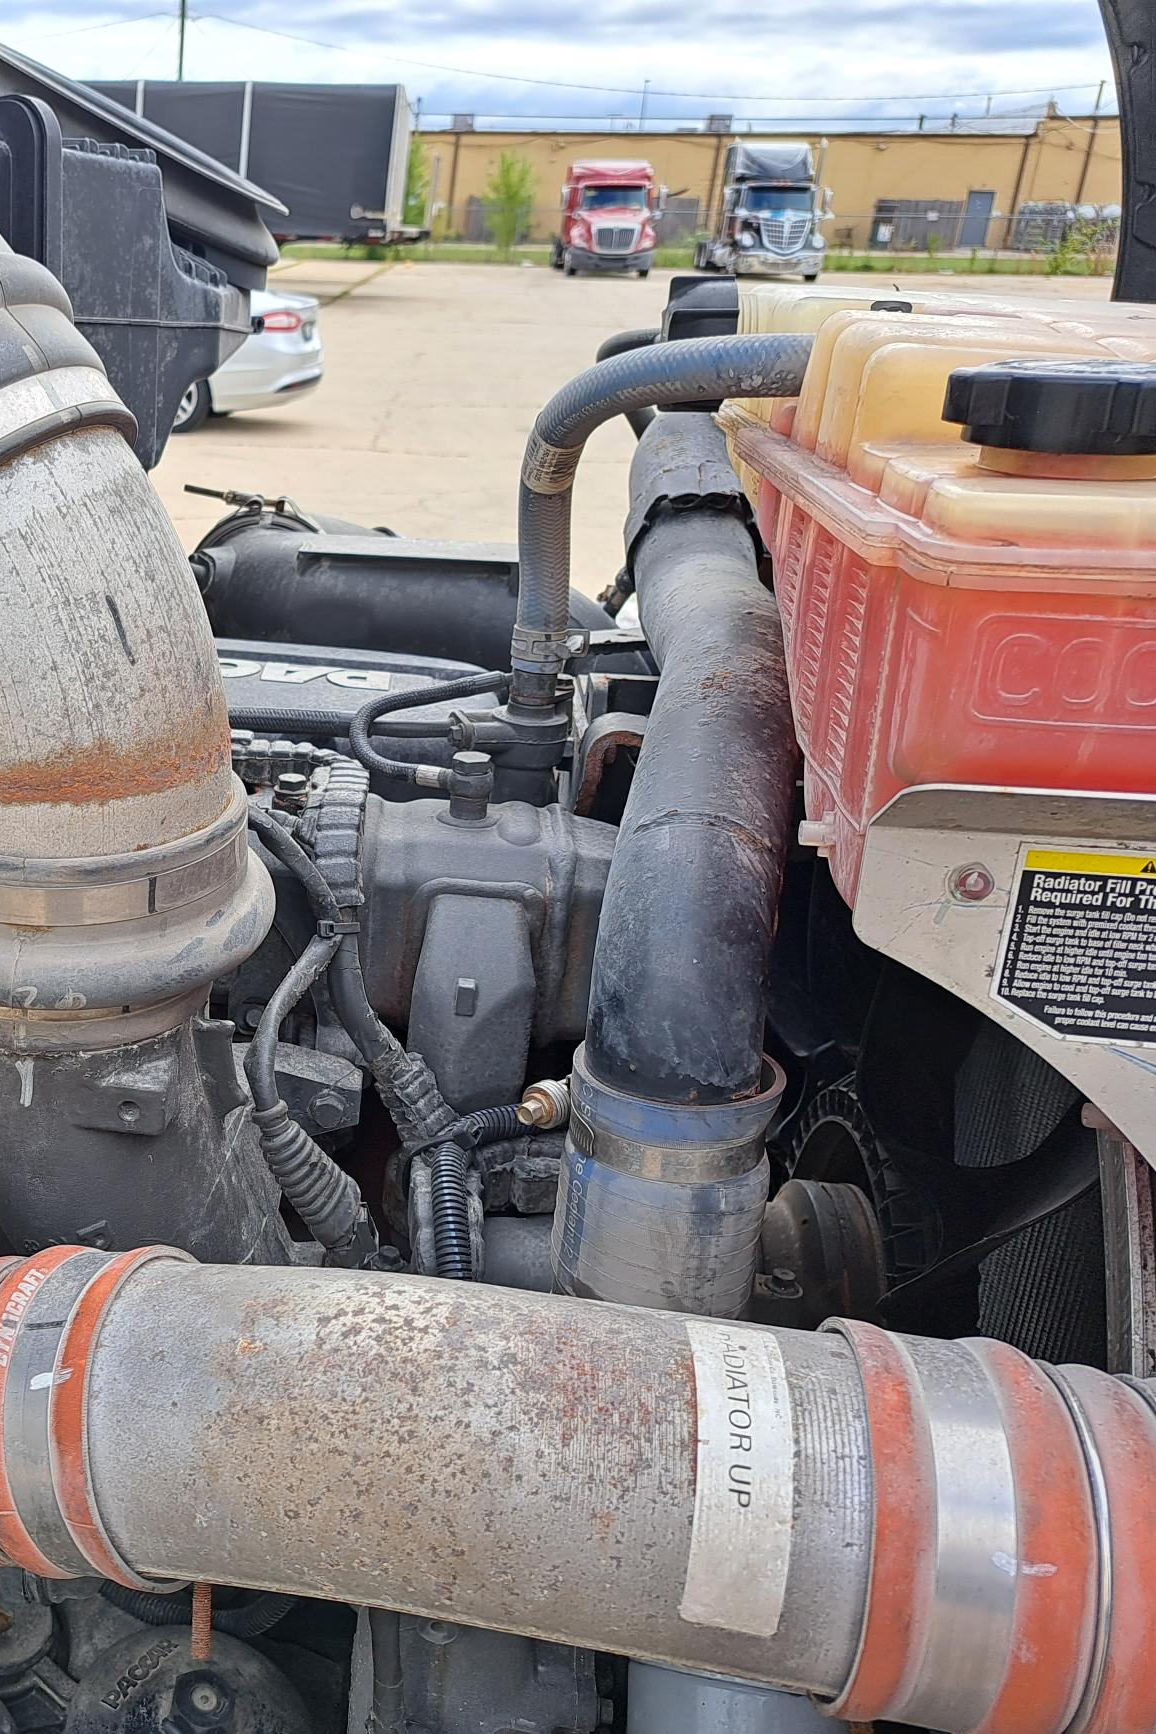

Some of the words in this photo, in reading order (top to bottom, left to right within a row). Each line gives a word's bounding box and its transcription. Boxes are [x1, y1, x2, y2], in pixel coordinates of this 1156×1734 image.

[1033, 874, 1102, 892] Radiator
[1106, 879, 1132, 894] Fill
[1030, 888, 1103, 908] Required
[1107, 893, 1135, 907] For
[1028, 906, 1054, 915] Remove
[1055, 908, 1065, 916] the
[1066, 910, 1084, 919] surge
[1085, 910, 1100, 918] tank
[1101, 911, 1110, 919] fill
[1111, 913, 1123, 922] cap
[1026, 915, 1037, 923] Fill
[1037, 916, 1048, 924] the
[1049, 918, 1071, 927] system
[1073, 919, 1086, 927] with
[1119, 922, 1143, 931] coolant
[1024, 924, 1040, 933] Start
[1041, 926, 1052, 934] the
[1052, 928, 1074, 937] engine
[1075, 928, 1087, 936] and
[1088, 929, 1100, 937] idle
[1101, 930, 1108, 938] at
[1109, 931, 1121, 939] low
[1122, 932, 1138, 940] RPM
[1138, 933, 1148, 941] for
[1023, 934, 1046, 944] Top-off
[1046, 937, 1064, 945] surge
[1080, 938, 1087, 946] to
[1088, 939, 1104, 947] base
[1105, 940, 1112, 948] of
[1113, 941, 1128, 949] filler
[1128, 942, 1144, 950] neck
[1021, 943, 1033, 951] Run
[1034, 945, 1055, 954] engine
[1064, 946, 1085, 956] higher
[1085, 948, 1097, 956] idle
[1114, 950, 1135, 960] engine
[1016, 961, 1030, 969] Run
[1030, 963, 1052, 972] engine
[1060, 965, 1080, 975] higher
[1019, 952, 1042, 960] Reduce
[1043, 954, 1054, 962] idle
[1063, 955, 1075, 963] low
[1076, 957, 1091, 965] RPM
[1092, 958, 1105, 966] and
[1105, 959, 1128, 969] top-off
[1127, 962, 1146, 971] surge
[1004, 969, 1010, 977] 8.
[1015, 970, 1038, 979] Reduce
[1039, 972, 1051, 980] idle
[1052, 973, 1059, 981] to
[1059, 974, 1071, 982] low
[1072, 975, 1087, 983] RPM
[1101, 977, 1124, 987] top-off
[1123, 980, 1142, 989] surge
[1011, 988, 1036, 999] Replace
[1047, 993, 1066, 1001] surge
[1067, 993, 1081, 1001] tank
[1082, 994, 1091, 1002] fill
[1091, 996, 1105, 1005] cap.
[1013, 980, 1031, 988] Allow
[1031, 981, 1053, 991] engine
[1075, 985, 1088, 993] and
[1088, 986, 1111, 996] top-off
[1111, 989, 1129, 997] surge
[1130, 989, 1145, 997] tank
[1044, 1005, 1066, 1014] Failure
[1074, 1008, 1094, 1017] follow
[1094, 1010, 1107, 1018] this
[1107, 1011, 1140, 1022] procedure
[1140, 1014, 1154, 1022] and
[1054, 1017, 1076, 1026] proper
[1076, 1018, 1100, 1027] coolant
[1101, 1020, 1116, 1028] level
[728, 1463, 752, 1509] UP
[100, 1638, 179, 1711] PACCAR
